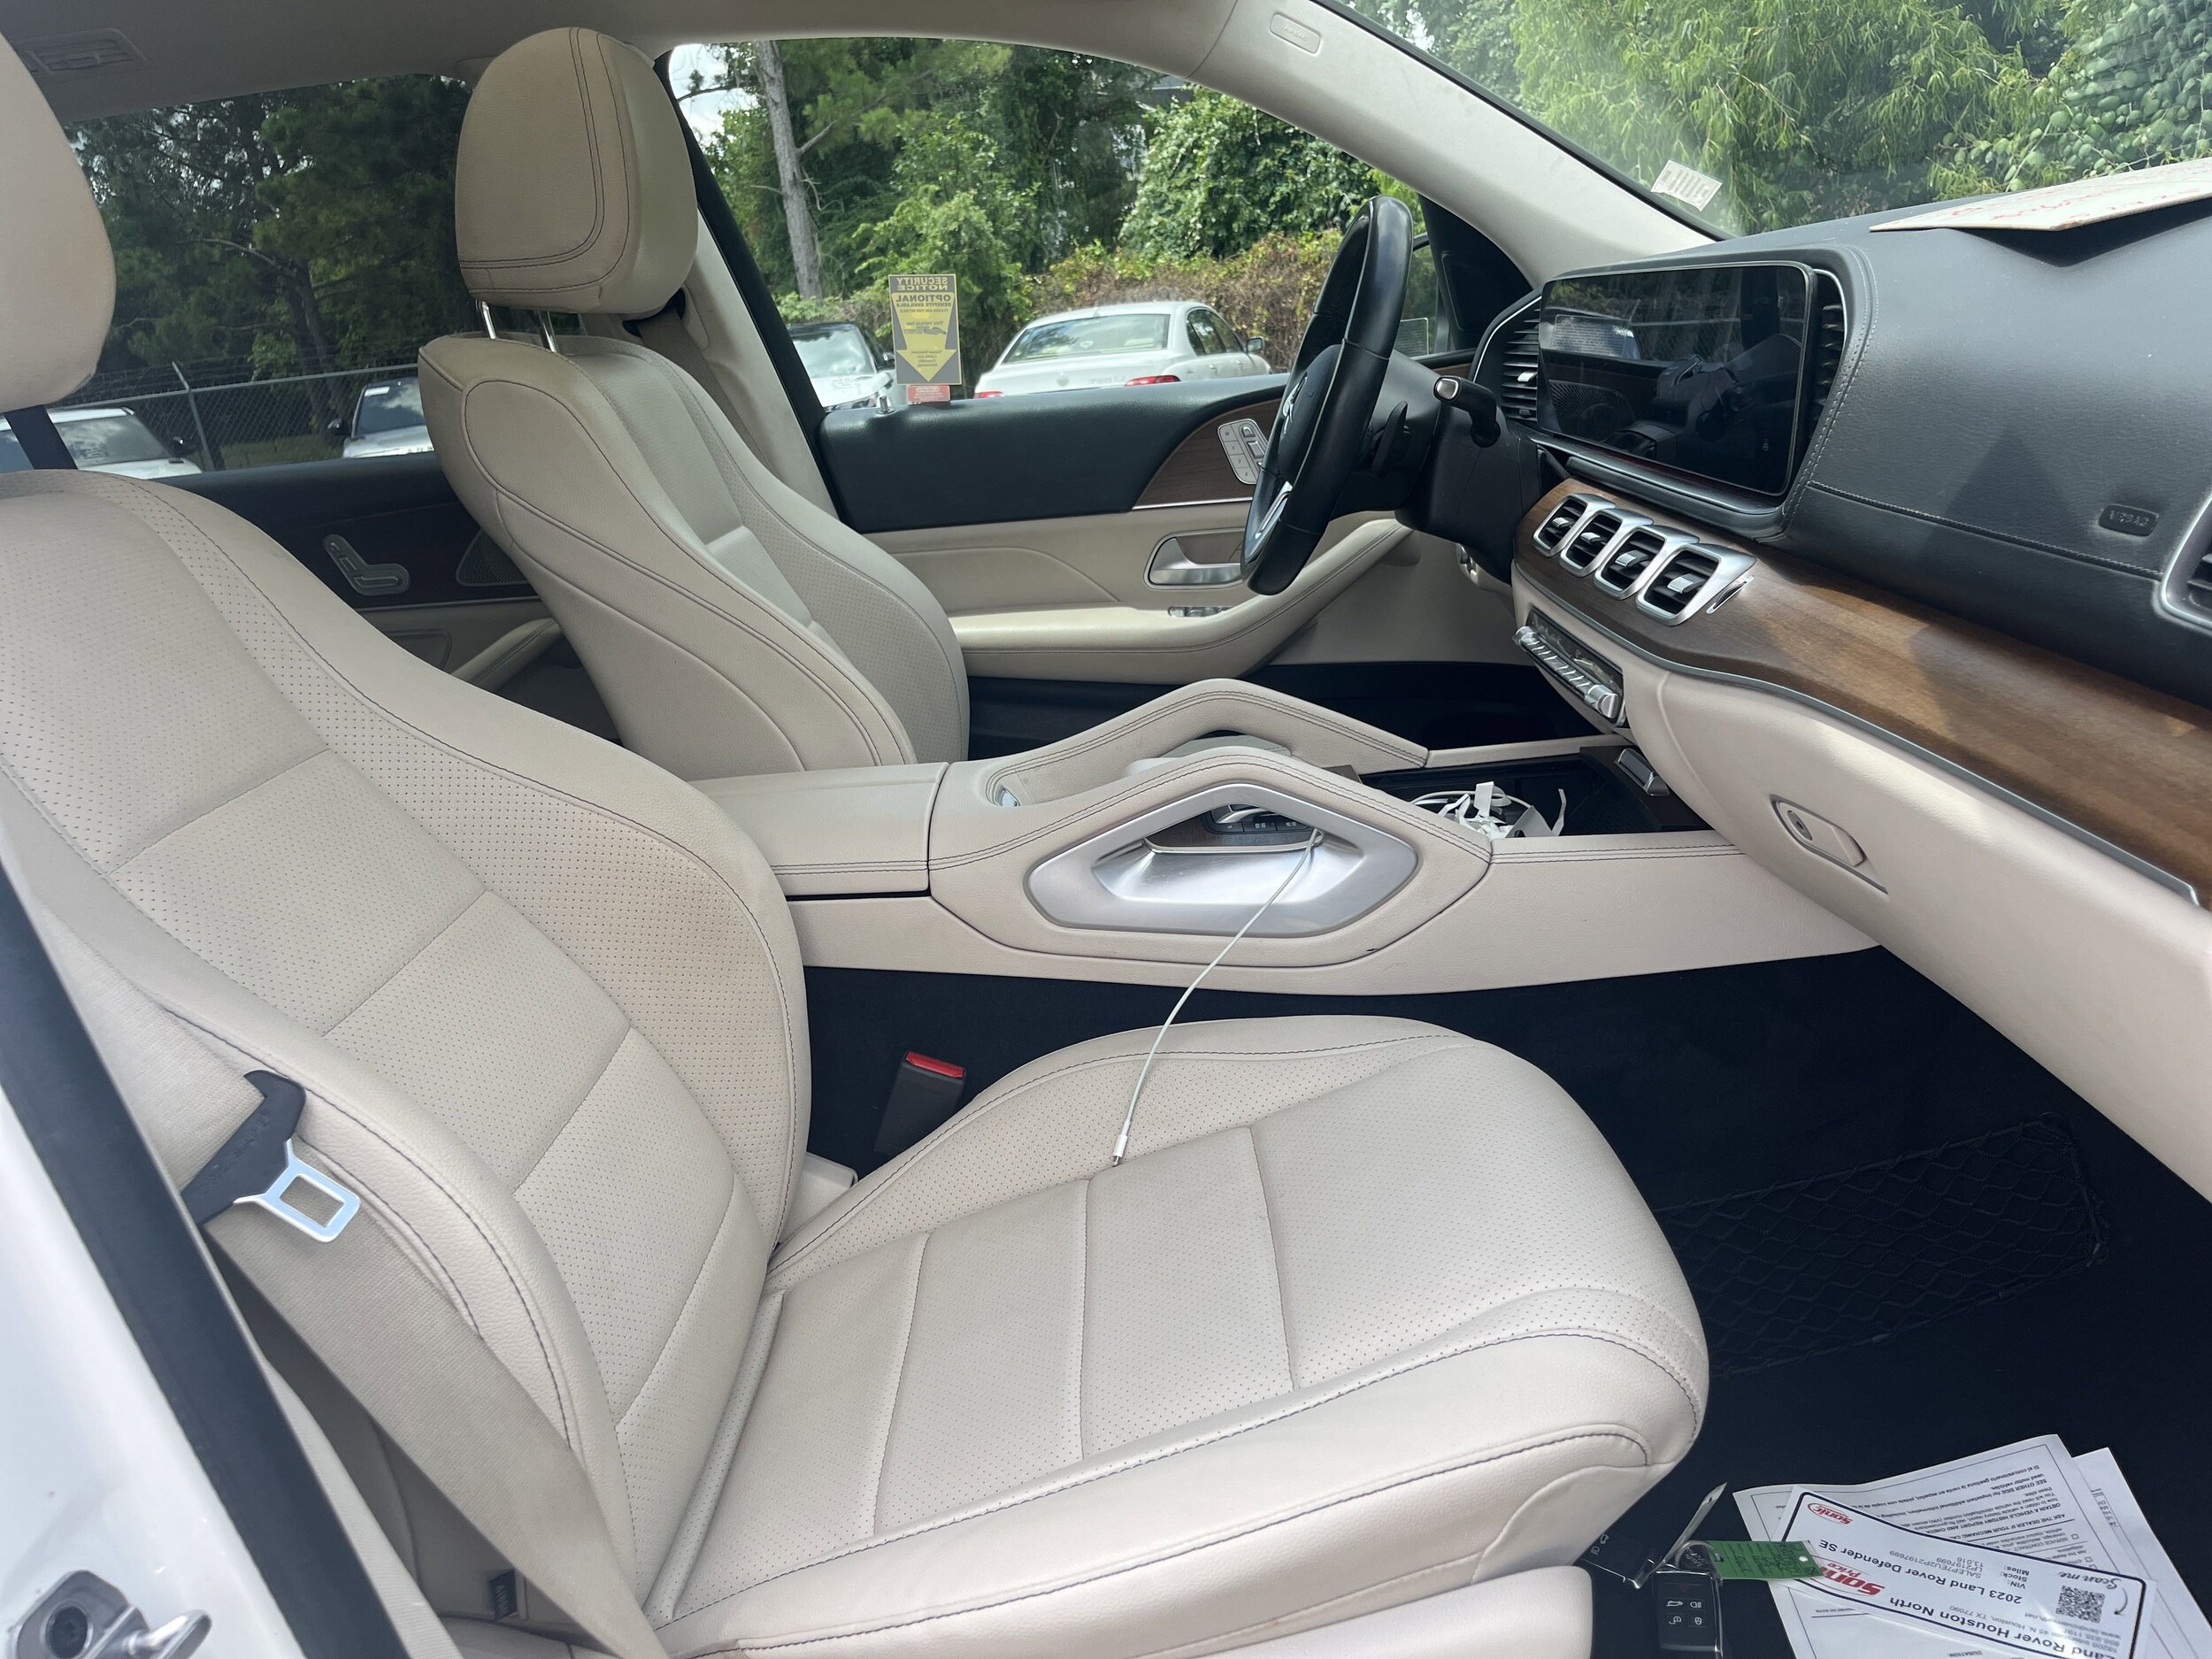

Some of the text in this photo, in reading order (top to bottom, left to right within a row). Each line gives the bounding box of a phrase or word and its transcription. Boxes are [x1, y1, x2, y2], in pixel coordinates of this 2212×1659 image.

[1966, 1494, 1992, 1502] important
[1812, 1506, 1853, 1525] Sonic
[1818, 1540, 2023, 1603] 2023 Land Rover Defender SE
[1826, 1563, 1862, 1578] Price
[1888, 1550, 2026, 1589] VIN: SALEP7EU2P2197699
[1936, 1557, 2028, 1582] Stock: LP2197699
[2003, 1566, 2030, 1575] Miles:
[2057, 1571, 2122, 1589] Scan me
[1889, 1597, 1934, 1616] North
[1949, 1605, 1973, 1616] 77090
[1939, 1612, 2009, 1638] Houston
[2014, 1633, 2065, 1653] Rover
